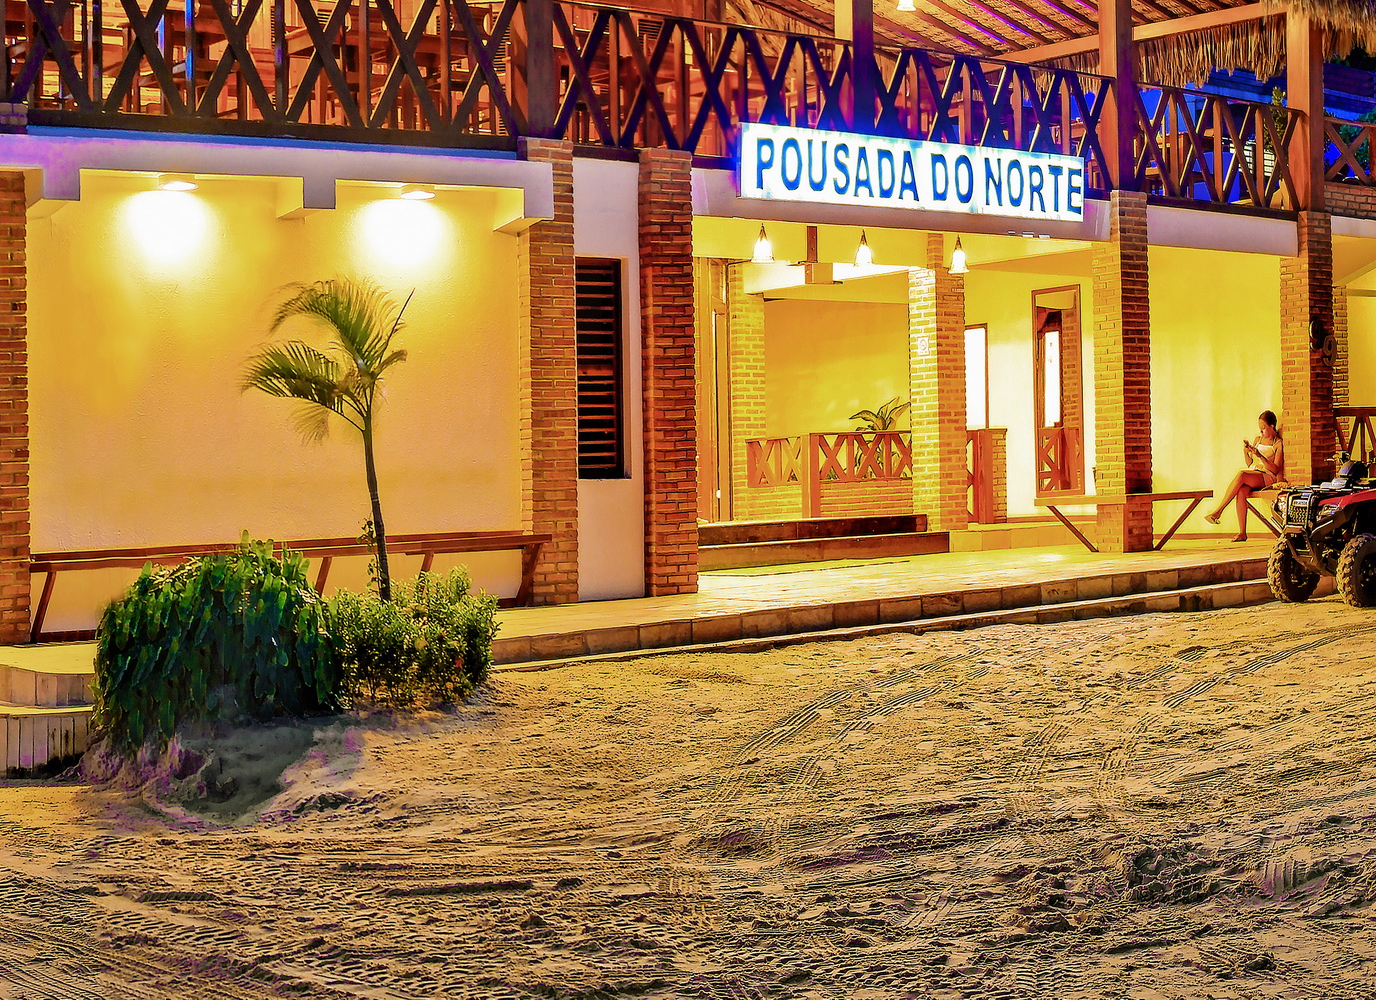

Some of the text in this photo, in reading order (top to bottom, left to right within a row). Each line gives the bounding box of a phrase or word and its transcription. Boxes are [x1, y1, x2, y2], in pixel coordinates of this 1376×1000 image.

[756, 137, 1082, 216] POUSADA DO NORTE
